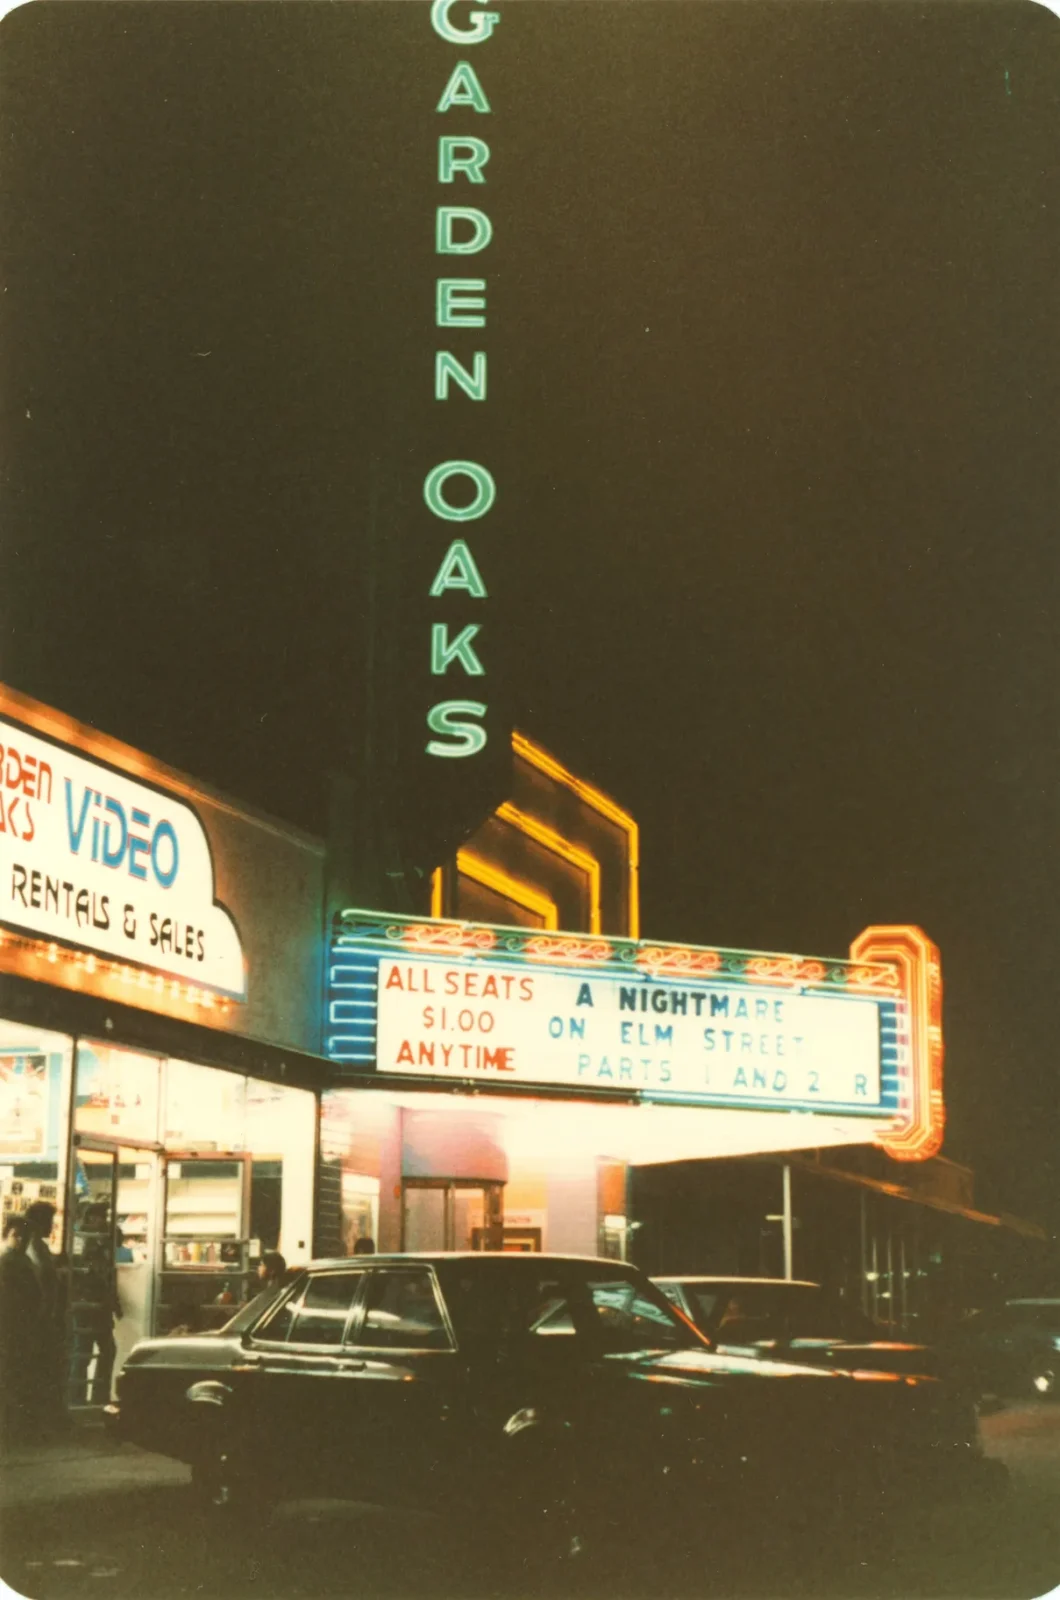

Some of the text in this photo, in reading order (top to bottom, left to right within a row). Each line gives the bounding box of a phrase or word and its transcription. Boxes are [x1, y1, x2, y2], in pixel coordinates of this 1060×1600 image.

[423, 0, 500, 759] GARDEN OAKS
[12, 863, 205, 962] RENTALS & SALES
[385, 965, 535, 1002] ALL SEATS
[576, 982, 784, 1023] A NIGHTMARE
[422, 1005, 495, 1034] $1.00
[548, 1016, 804, 1056] ON ELM STREET
[395, 1040, 516, 1072] ANYTIME
[577, 1053, 672, 1082] PARTS
[733, 1066, 788, 1093] AND
[807, 1071, 820, 1093] 2
[854, 1073, 868, 1096] R
